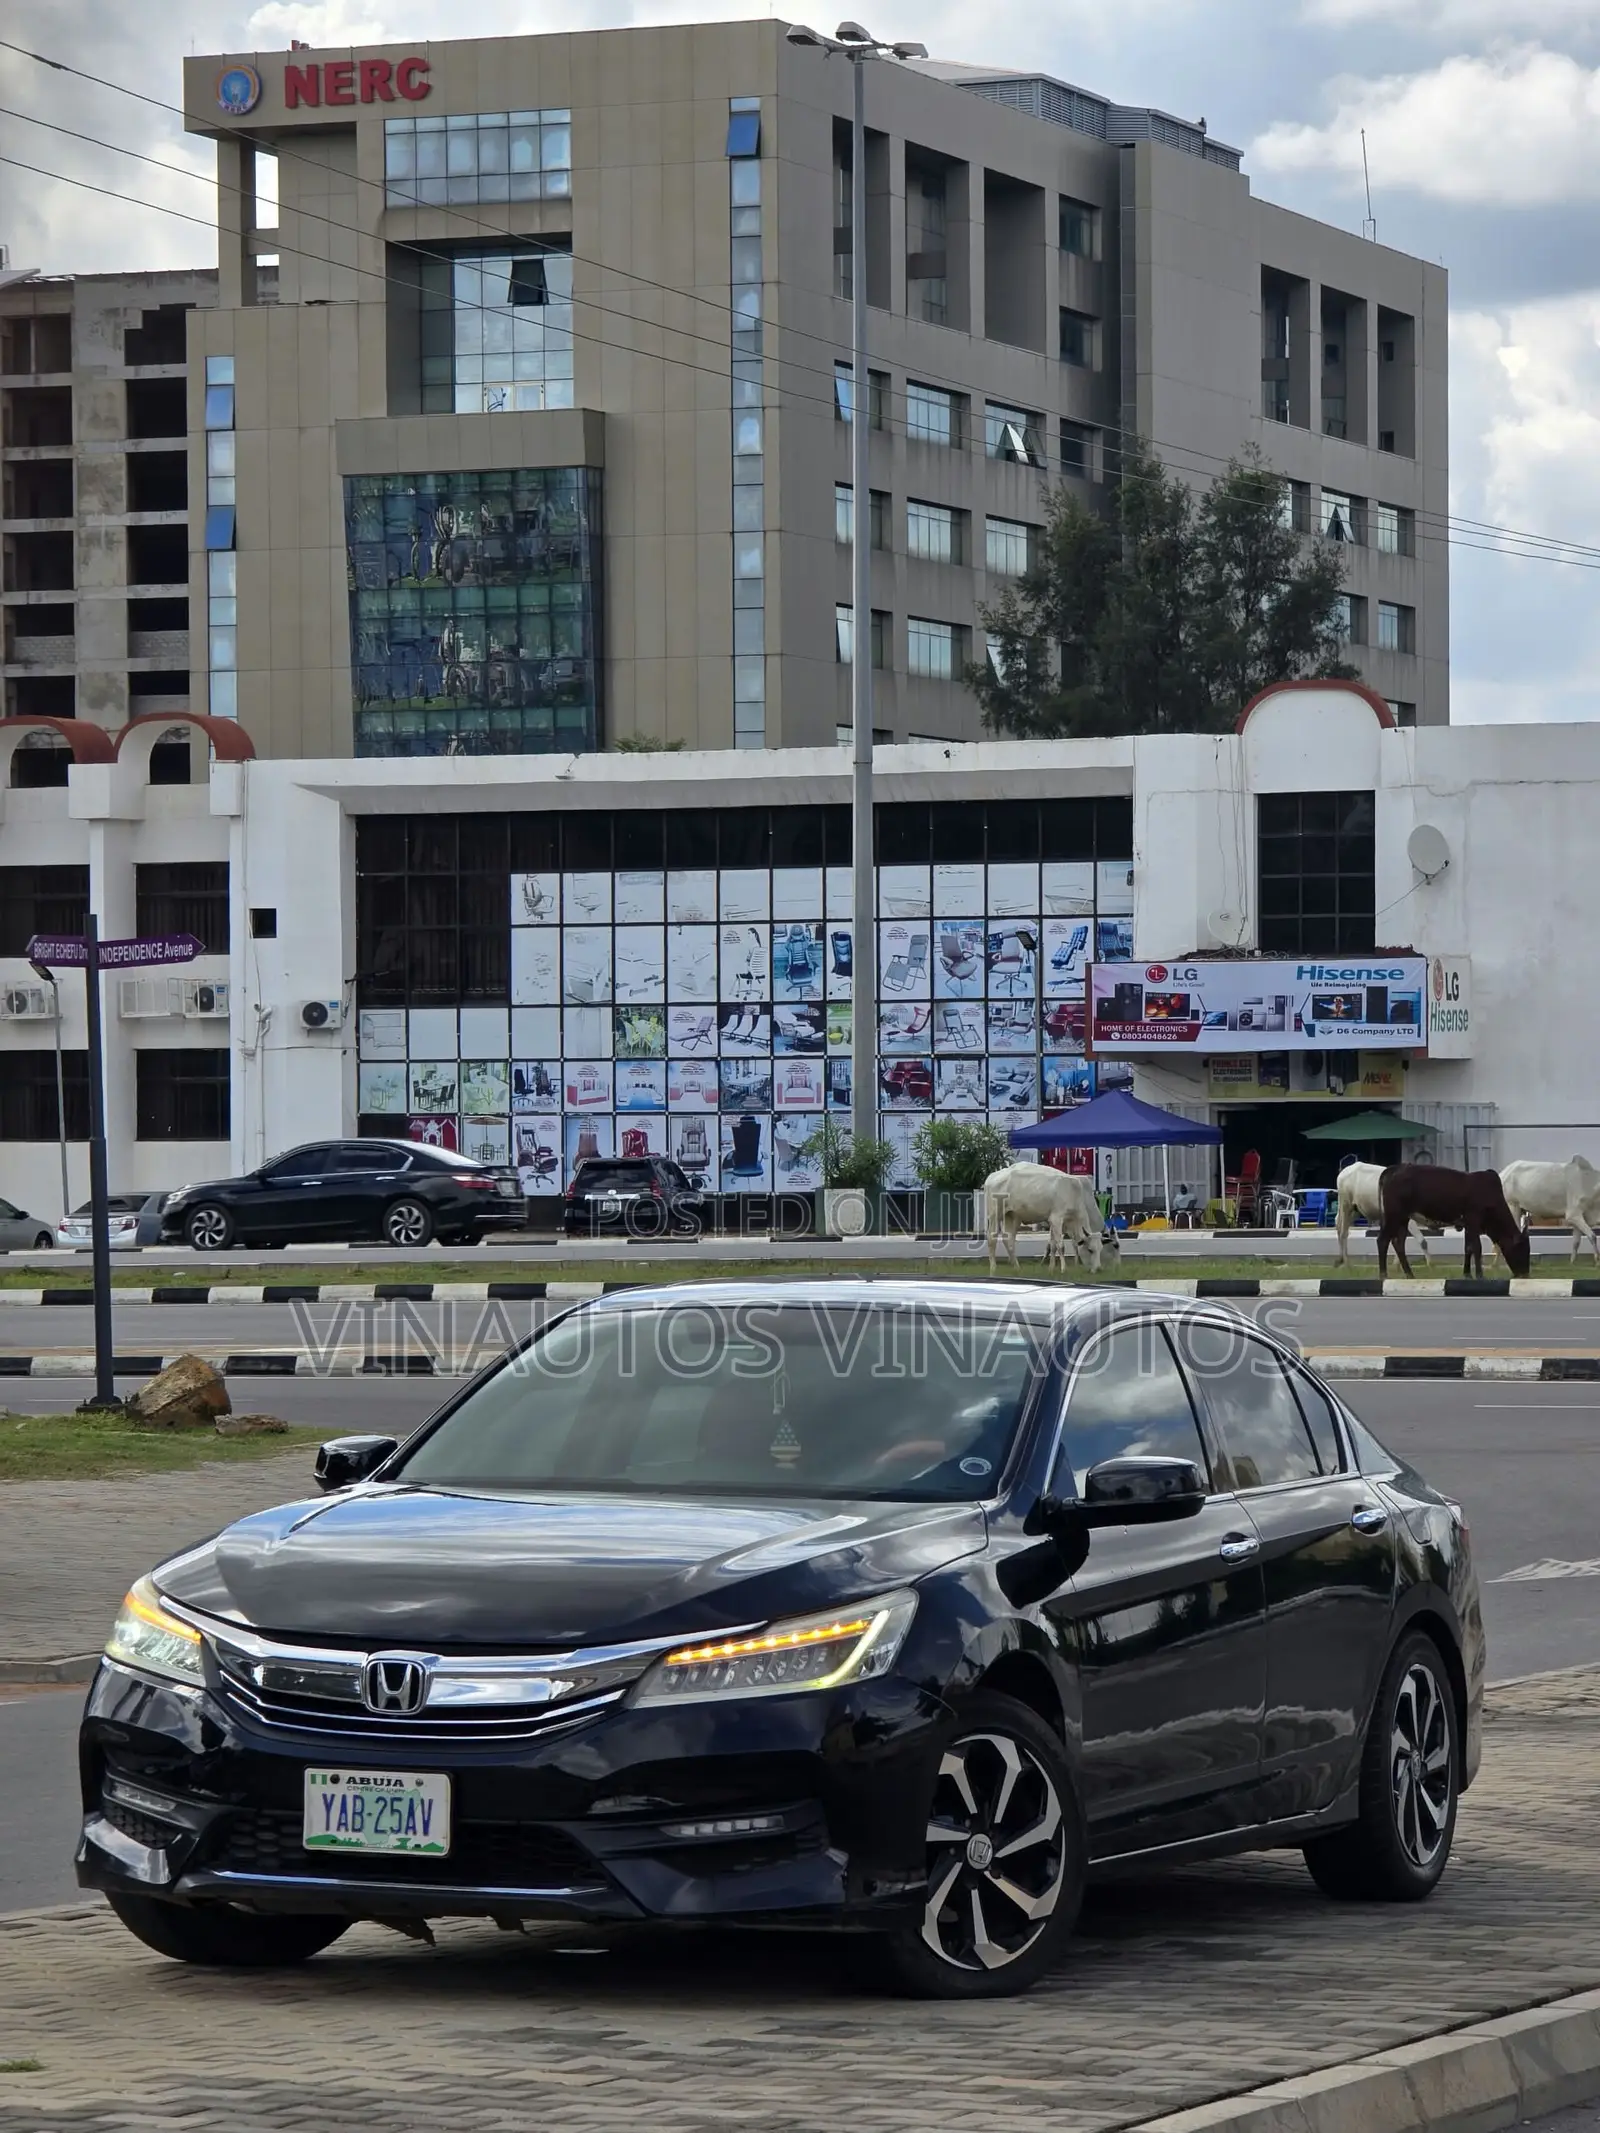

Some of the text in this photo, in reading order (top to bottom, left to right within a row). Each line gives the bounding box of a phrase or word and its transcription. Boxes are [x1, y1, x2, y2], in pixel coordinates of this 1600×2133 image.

[285, 57, 432, 109] NERC
[34, 943, 55, 958] BRIGHT
[56, 943, 79, 959] ECHEFU
[99, 942, 193, 963] INDEPENDENCE Avenue
[1173, 968, 1198, 981] LG
[1296, 965, 1405, 981] Hisense
[1445, 972, 1459, 1000] LG
[1430, 1001, 1469, 1032] Hisense
[1122, 1033, 1178, 1041] 08034048626
[1136, 1025, 1188, 1033] ELECTRONICS
[1351, 1028, 1395, 1036] Company
[345, 1776, 404, 1788] ABUJA
